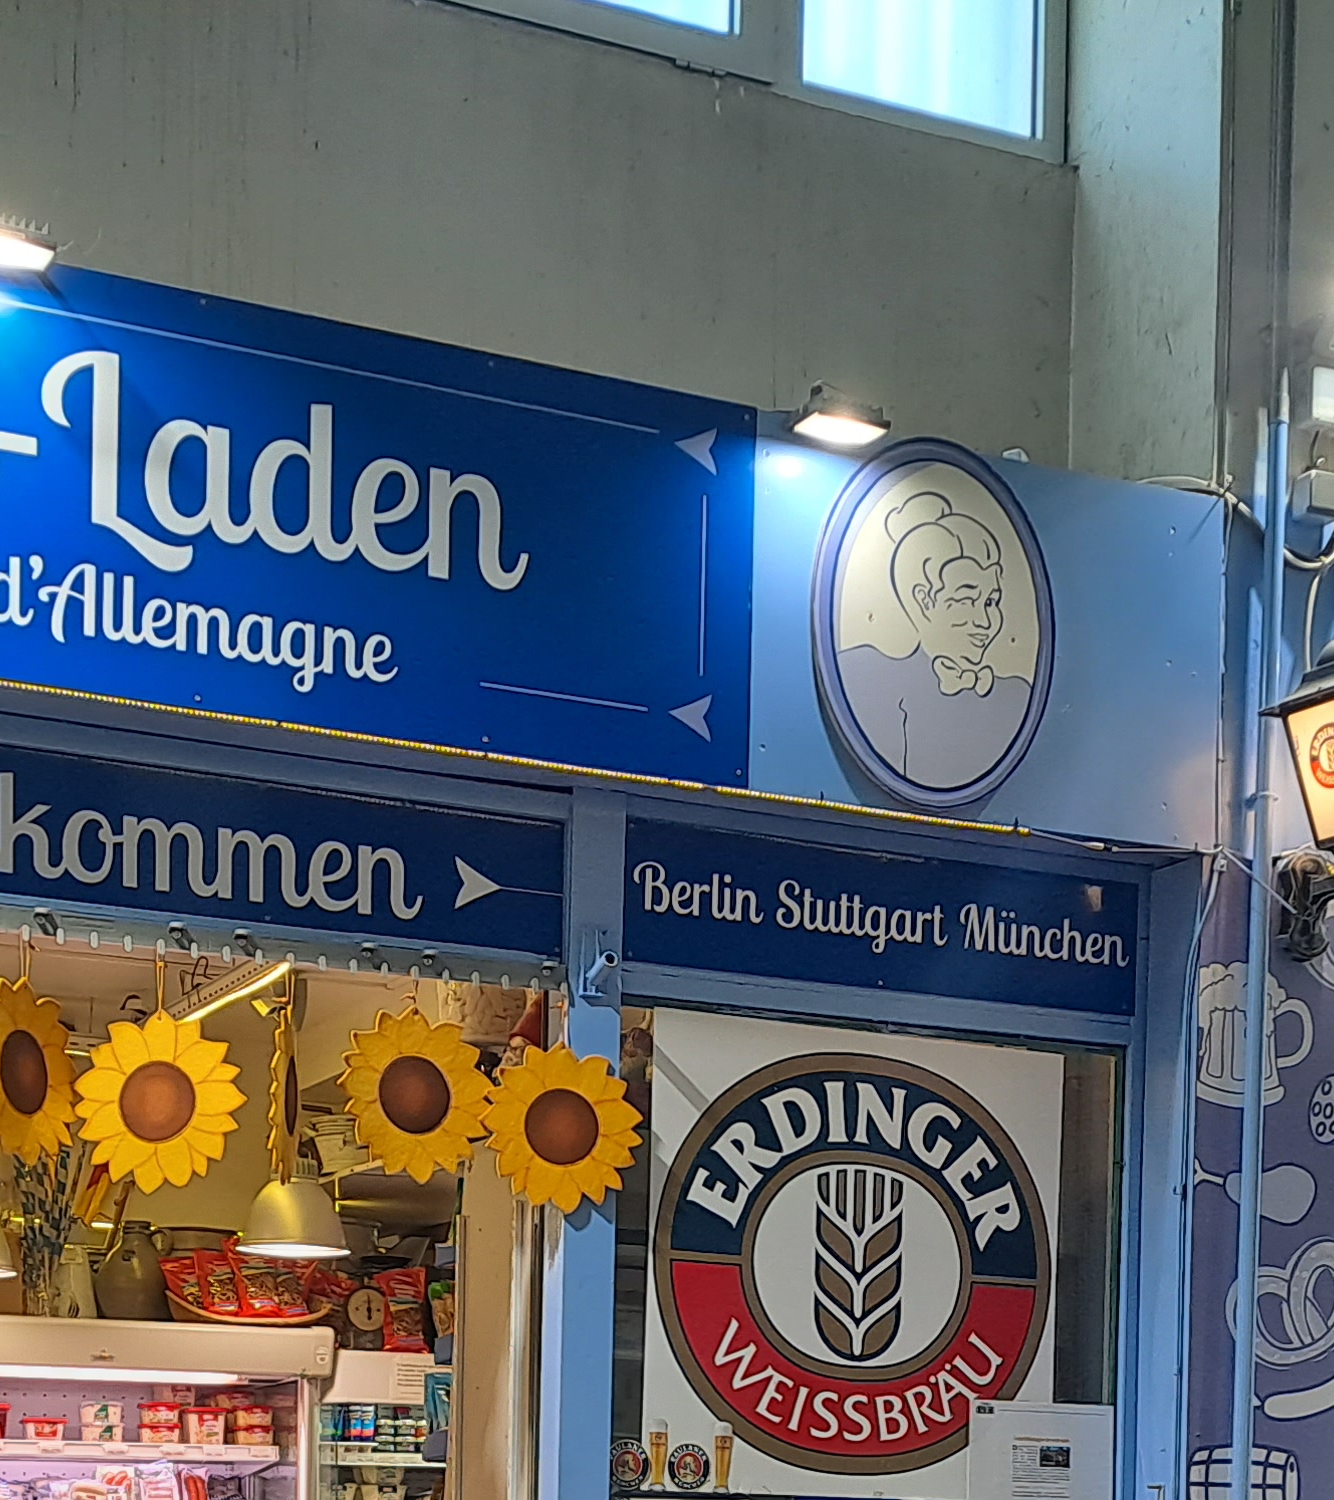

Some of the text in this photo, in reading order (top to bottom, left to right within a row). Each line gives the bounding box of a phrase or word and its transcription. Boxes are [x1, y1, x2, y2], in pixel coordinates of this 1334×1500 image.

[633, 861, 1129, 968] Berlin Stuttgart München
[686, 1080, 1022, 1252] ERDINGER
[713, 1317, 1003, 1442] WEISSBRÄU
